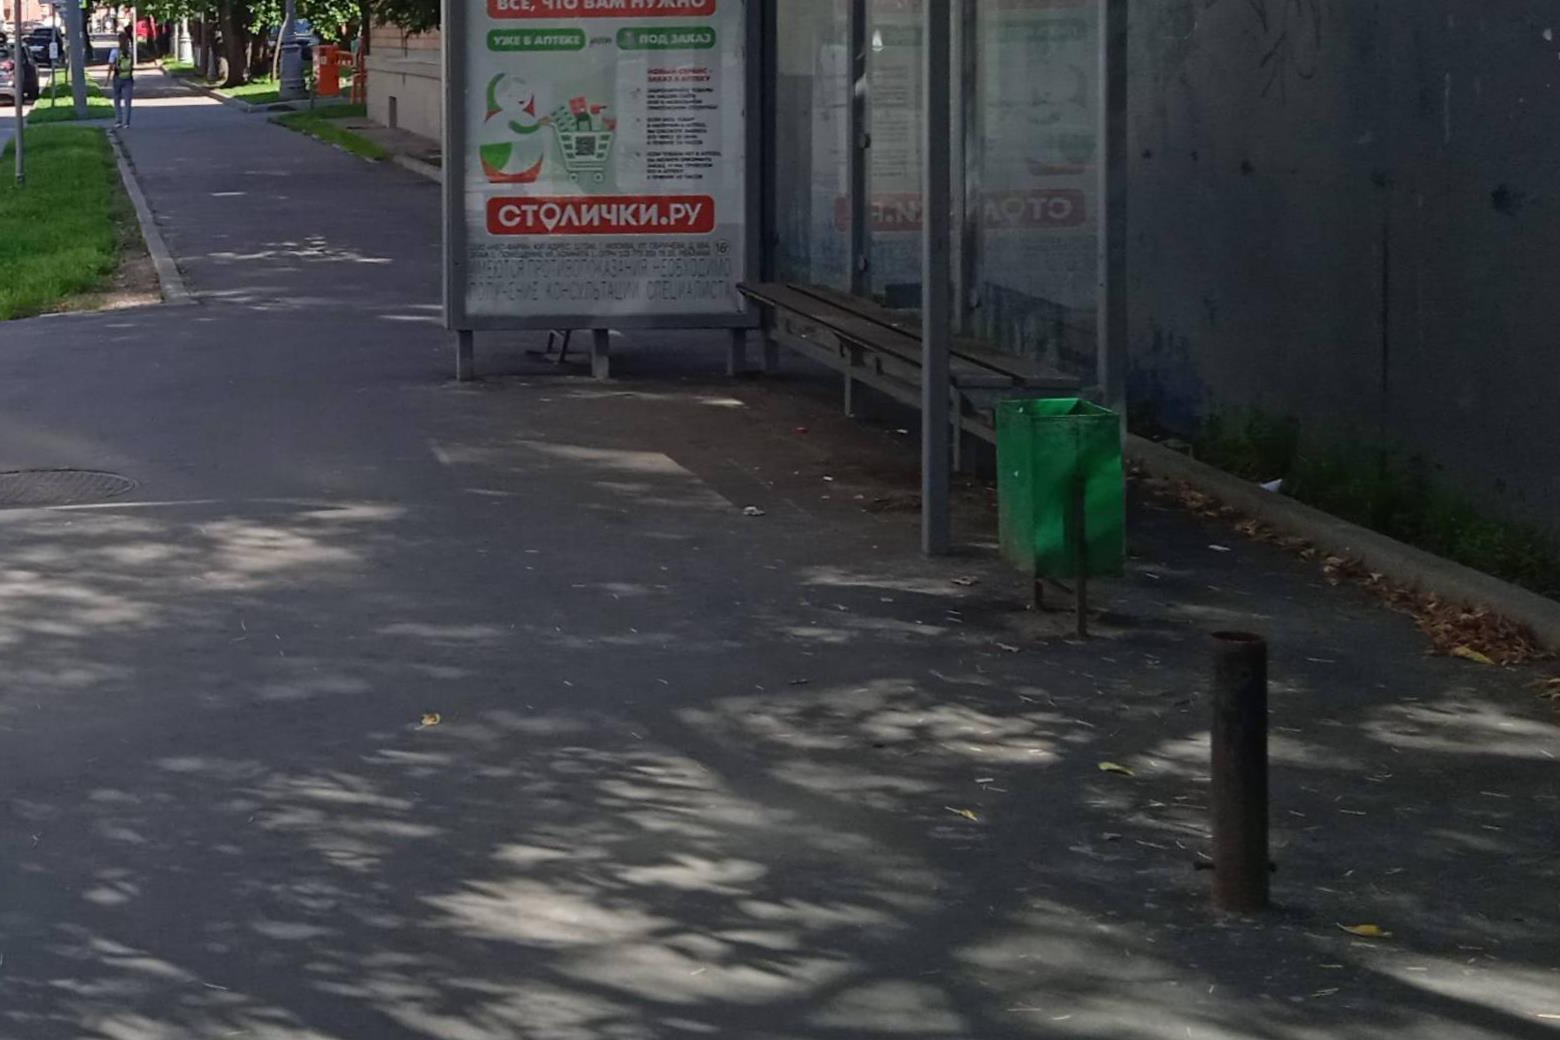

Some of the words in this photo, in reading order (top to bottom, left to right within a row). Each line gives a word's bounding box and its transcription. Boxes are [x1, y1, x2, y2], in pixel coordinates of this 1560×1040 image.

[493, 35, 521, 46] УЖЕ
[534, 34, 581, 46] АПТЕКЕ
[640, 34, 668, 45] ПОД
[671, 33, 712, 44] ЗАКАЗ
[497, 202, 702, 232] СТОЛИЧКИ.РУ
